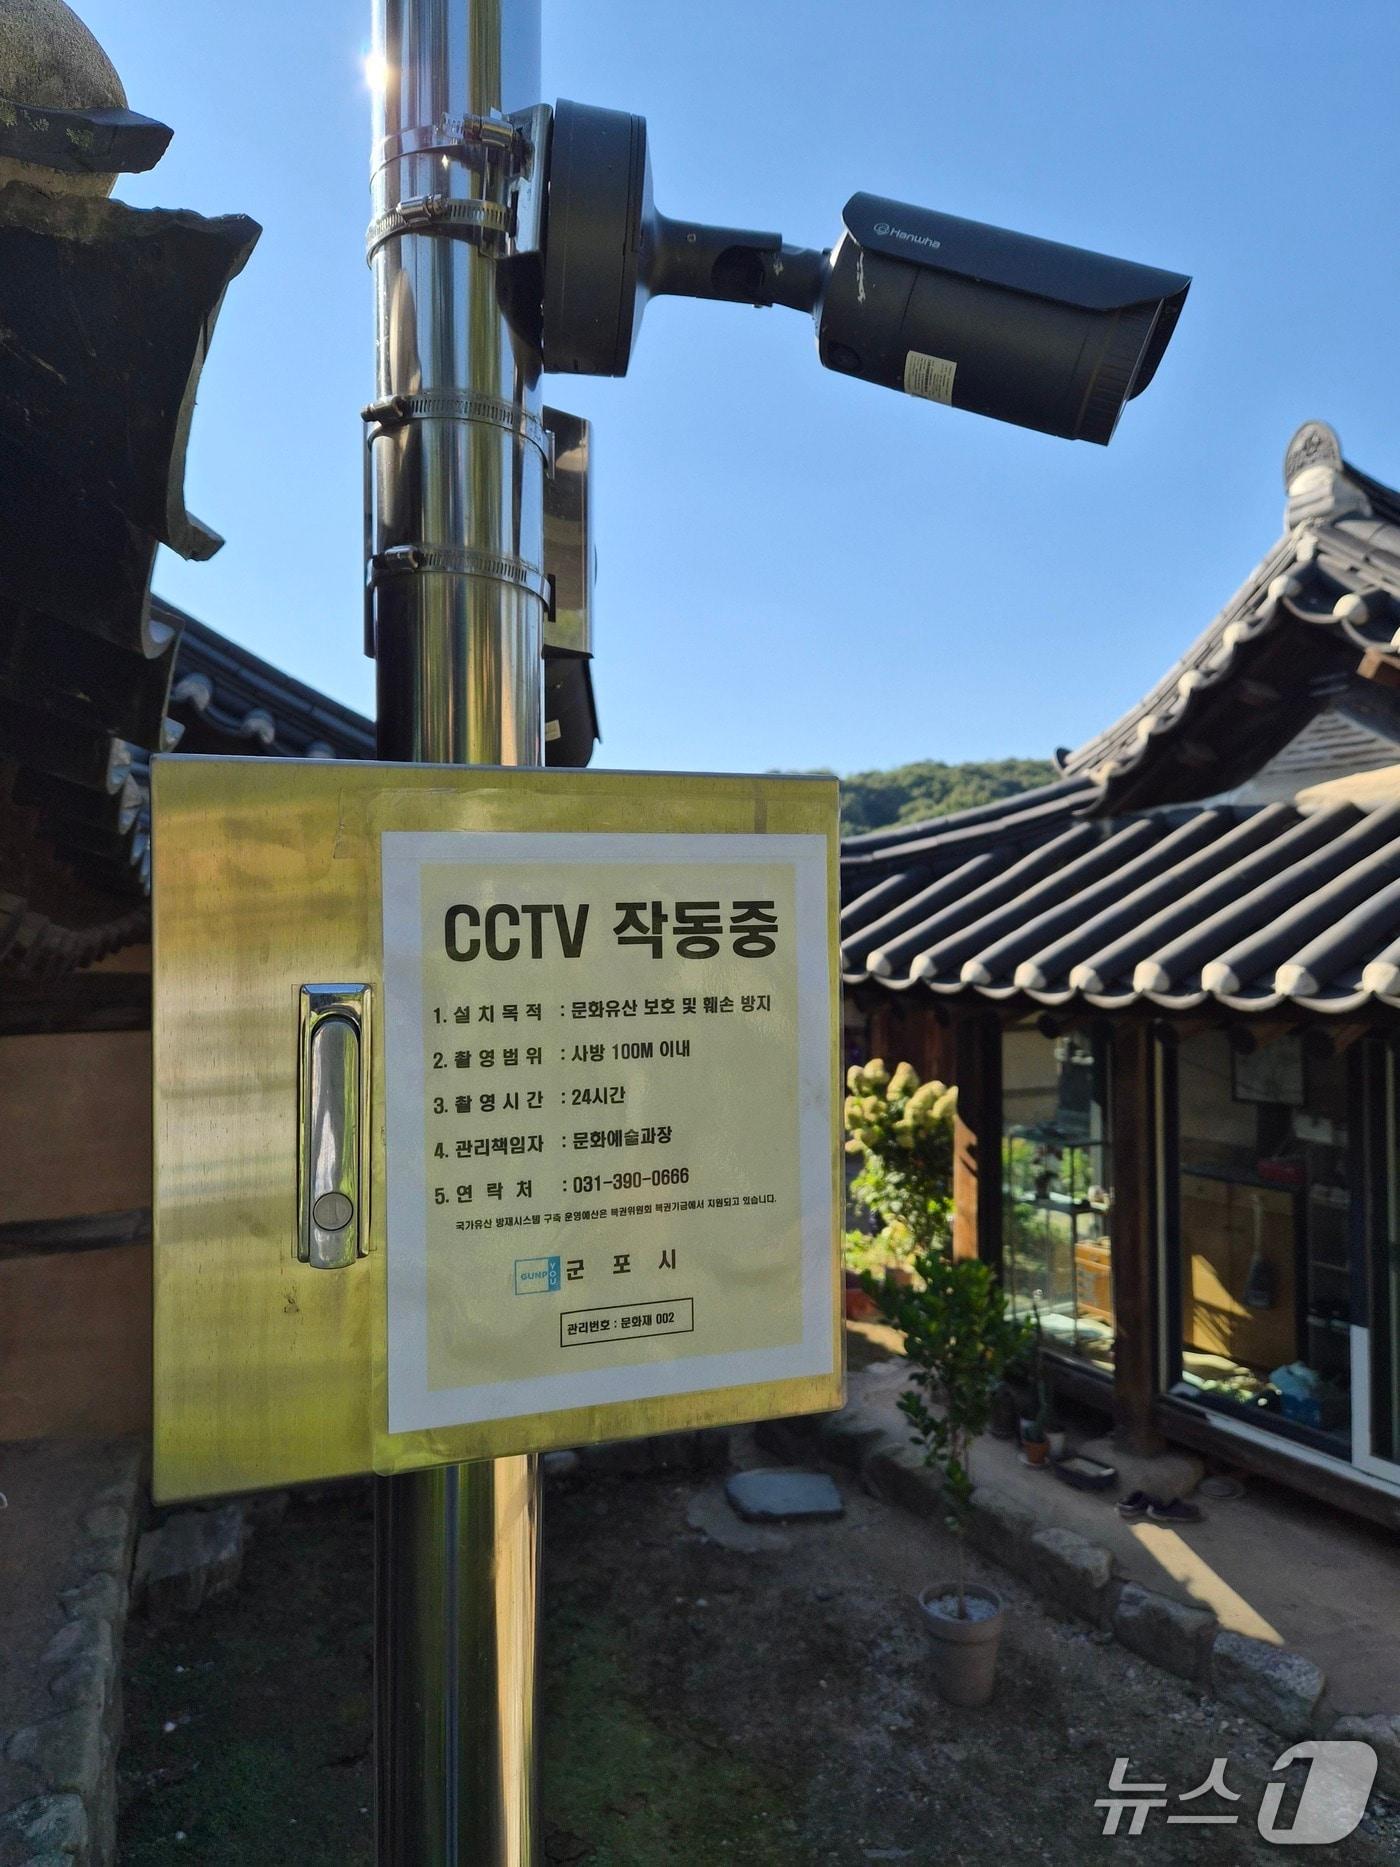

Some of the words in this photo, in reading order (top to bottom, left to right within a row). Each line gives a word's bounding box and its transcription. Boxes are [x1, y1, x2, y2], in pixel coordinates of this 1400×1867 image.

[890, 228, 941, 249] Hanwha
[444, 903, 590, 963] CCTV
[612, 900, 779, 960] 작동중
[433, 1007, 447, 1024] 1.
[571, 999, 638, 1019] 문화유산
[644, 997, 676, 1015] 보호
[682, 996, 697, 1015] 및
[703, 996, 734, 1014] 훼손
[740, 994, 771, 1013] 방지
[433, 1051, 448, 1070] 2.
[571, 1043, 606, 1063] 사방
[612, 1041, 654, 1060] 100M
[659, 1039, 690, 1058] 이내
[433, 1097, 449, 1115] 3.
[571, 1085, 626, 1106] 24시간
[433, 1142, 449, 1159] 4.
[455, 1134, 544, 1159] 관리책임자
[572, 1125, 673, 1150] 문화예술과장
[434, 1187, 450, 1205] 5.
[573, 1167, 690, 1194] 031-390-0666
[455, 1218, 493, 1231] 국가유산
[495, 1214, 541, 1228] 방재시스템
[543, 1213, 562, 1224] 구축
[564, 1208, 608, 1222] 운영예산은
[707, 1196, 740, 1208] 지원되고
[742, 1193, 777, 1206] 있습니다.
[567, 1319, 611, 1336] 관리번호
[620, 1314, 653, 1329] 문화재
[655, 1311, 675, 1325] 002
